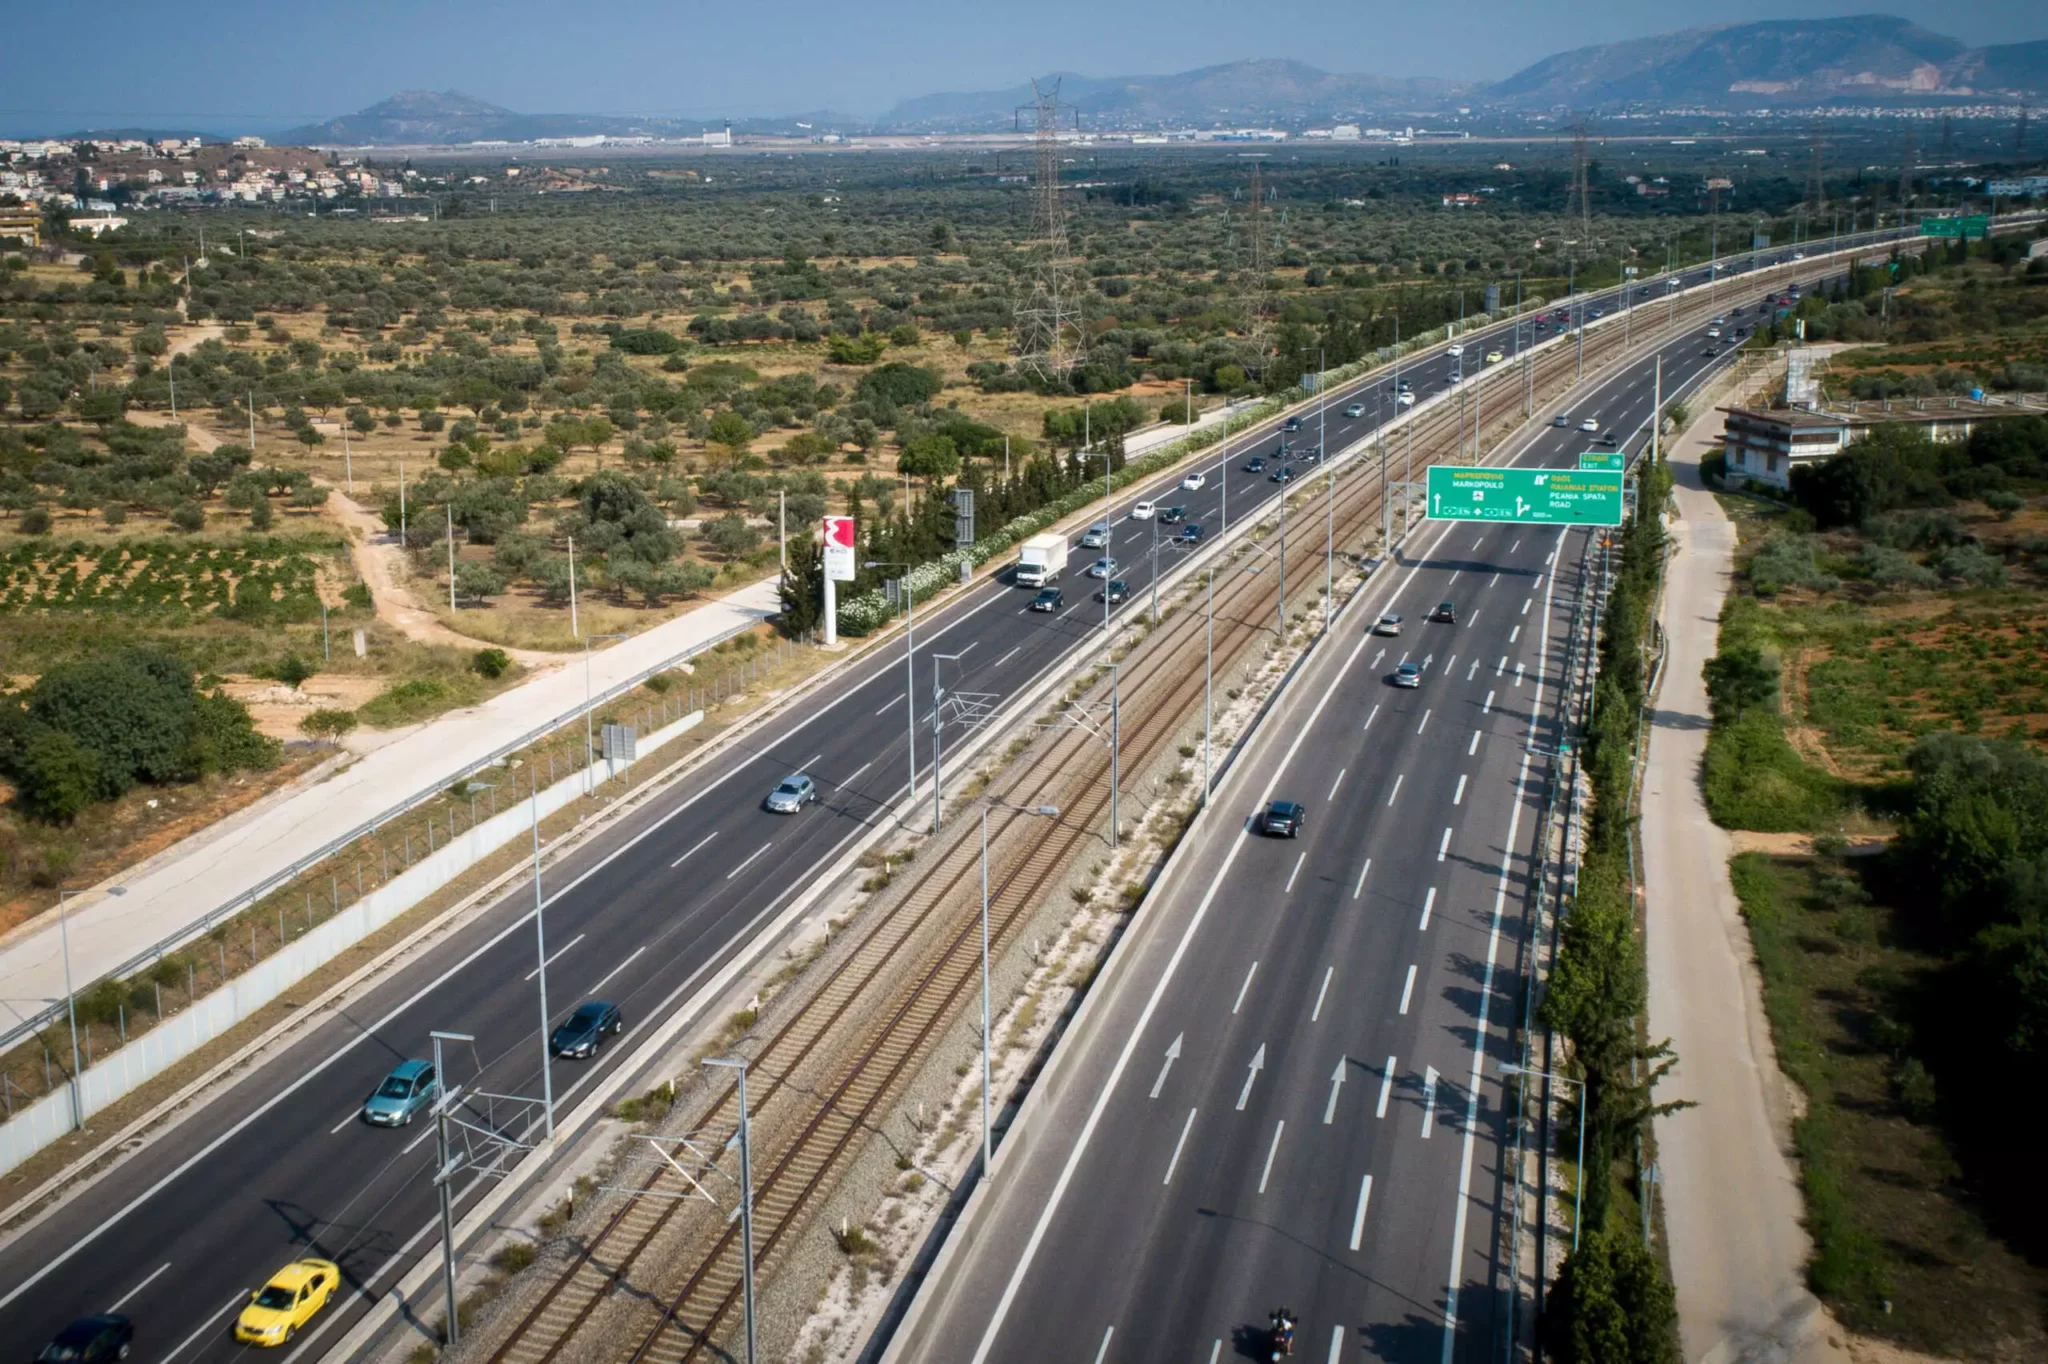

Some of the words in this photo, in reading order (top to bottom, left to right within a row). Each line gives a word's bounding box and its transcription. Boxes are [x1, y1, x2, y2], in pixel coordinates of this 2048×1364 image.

[1452, 481, 1504, 489] MARKOPOULO
[1550, 492, 1579, 500] PEANIA
[1583, 493, 1606, 501] SPATA
